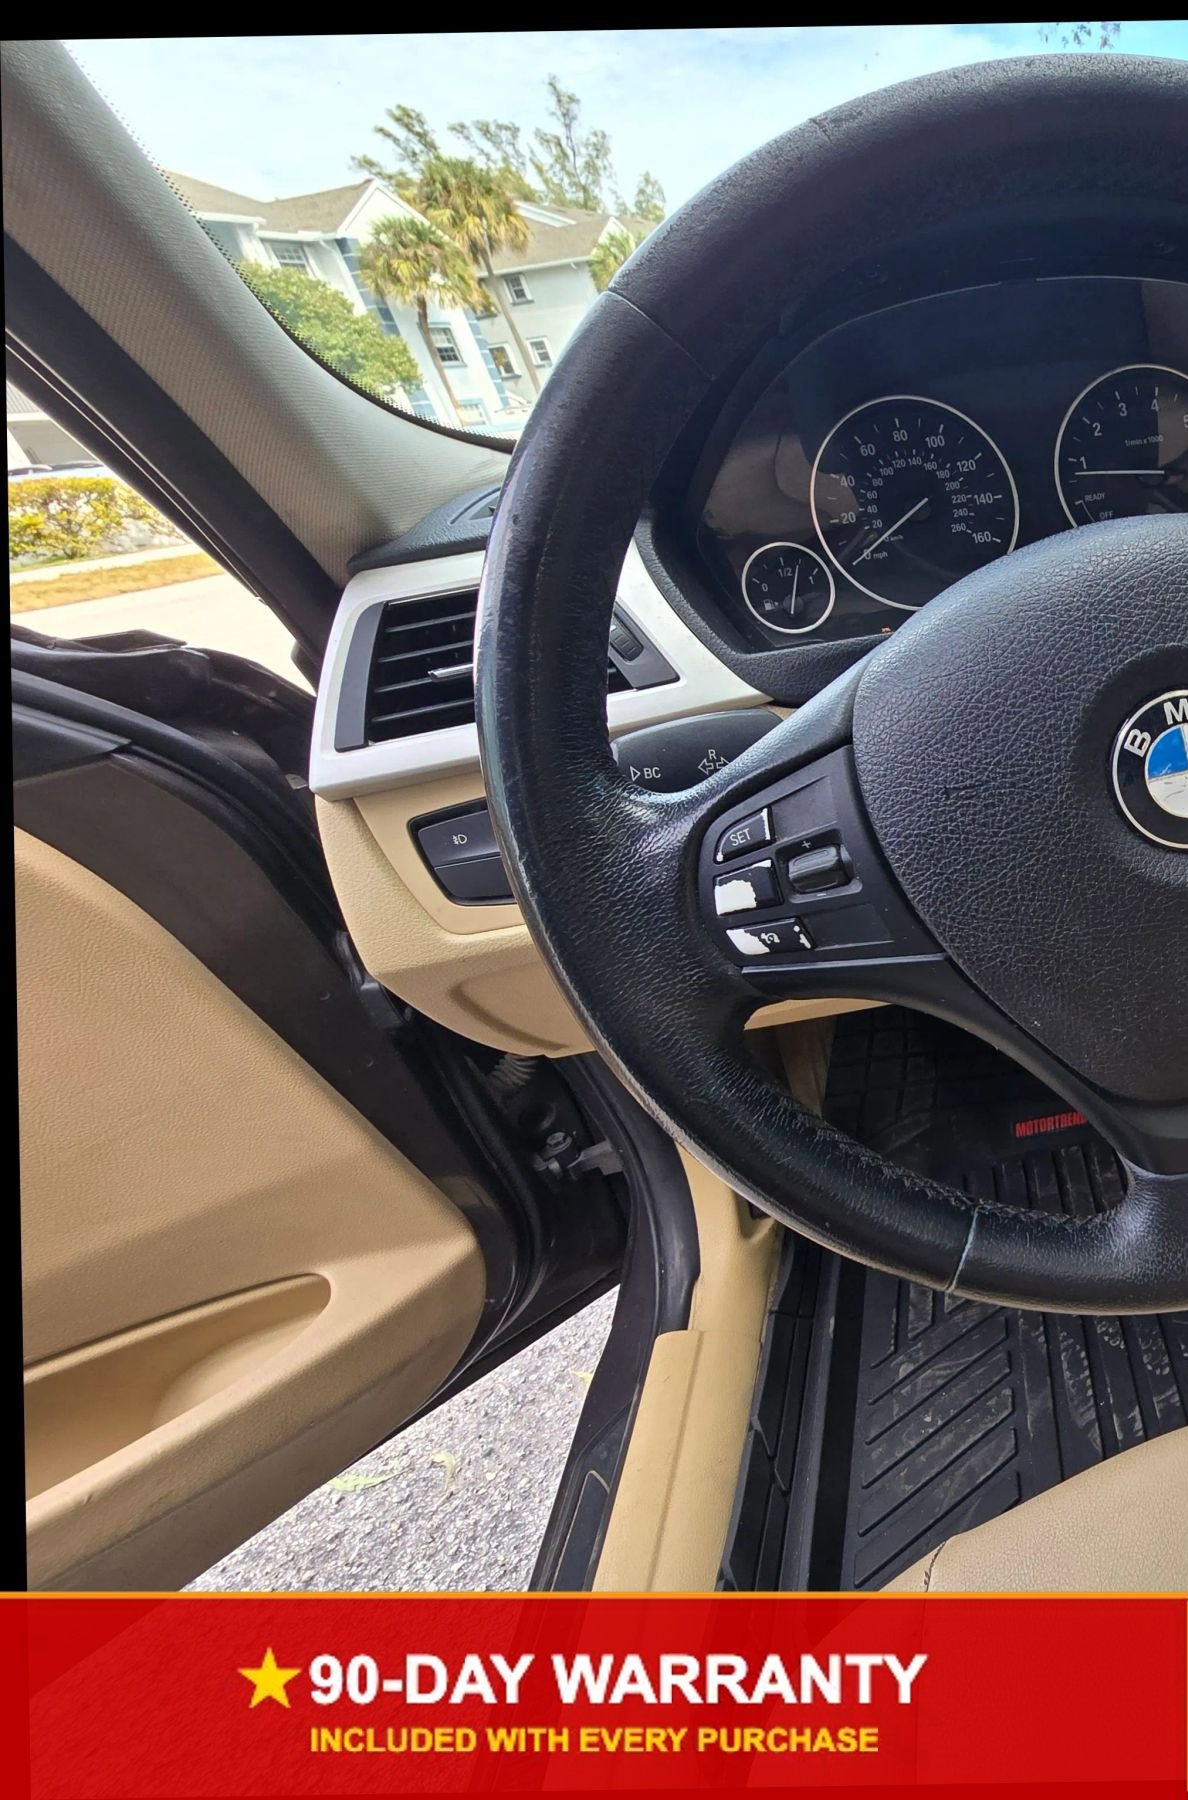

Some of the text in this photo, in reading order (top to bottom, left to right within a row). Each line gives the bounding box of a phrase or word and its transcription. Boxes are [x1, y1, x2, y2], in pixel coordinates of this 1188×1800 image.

[1118, 402, 1128, 417] 3
[1151, 399, 1159, 412] 4
[1092, 423, 1102, 437] 2
[893, 429, 908, 442] 80
[925, 435, 945, 448] 100
[860, 444, 876, 457] 60
[892, 459, 906, 468] 120
[908, 457, 922, 466] 140
[923, 461, 938, 471] 160
[957, 459, 976, 472] 120
[1079, 456, 1087, 470] 1
[880, 467, 894, 476] 100
[936, 469, 950, 479] 180
[840, 475, 855, 488] 40
[872, 478, 883, 487] 80
[945, 481, 960, 491] 200
[866, 491, 877, 499] 60
[952, 494, 967, 503] 220
[973, 492, 993, 505] 140
[1084, 492, 1105, 502] READY
[866, 505, 878, 513] 40
[953, 508, 968, 517] 240
[841, 511, 856, 525] 20
[1100, 511, 1114, 520] OFF
[872, 520, 883, 529] 20
[951, 523, 966, 533] 260
[972, 531, 991, 544] 160
[873, 551, 888, 560] mph
[778, 568, 792, 577] 1/2
[761, 582, 769, 592] 0
[708, 749, 717, 759] R
[644, 767, 661, 779] BC
[729, 830, 750, 846] SET
